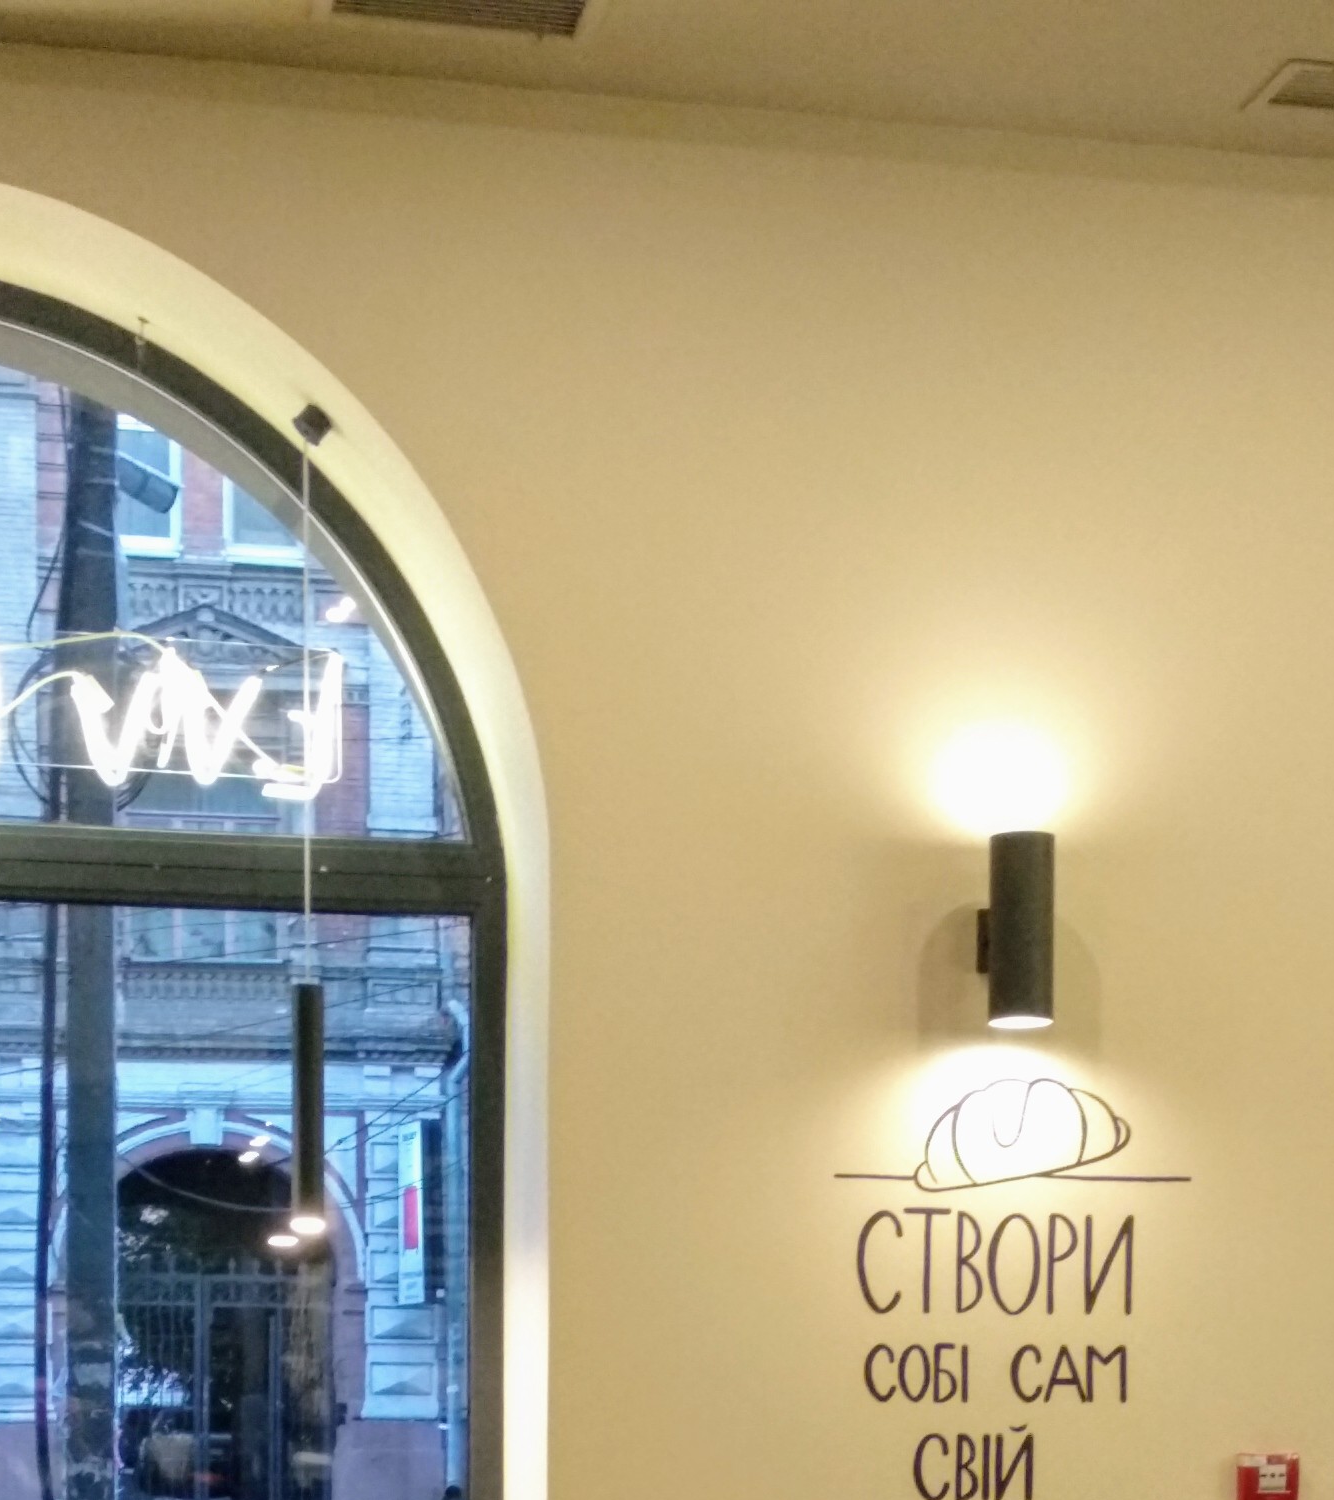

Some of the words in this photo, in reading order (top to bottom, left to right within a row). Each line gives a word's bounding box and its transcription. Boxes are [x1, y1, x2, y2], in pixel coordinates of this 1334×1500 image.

[855, 1205, 1135, 1316] СТВОРИ
[862, 1342, 971, 1404] СОБІ
[1009, 1343, 1129, 1404] САМ
